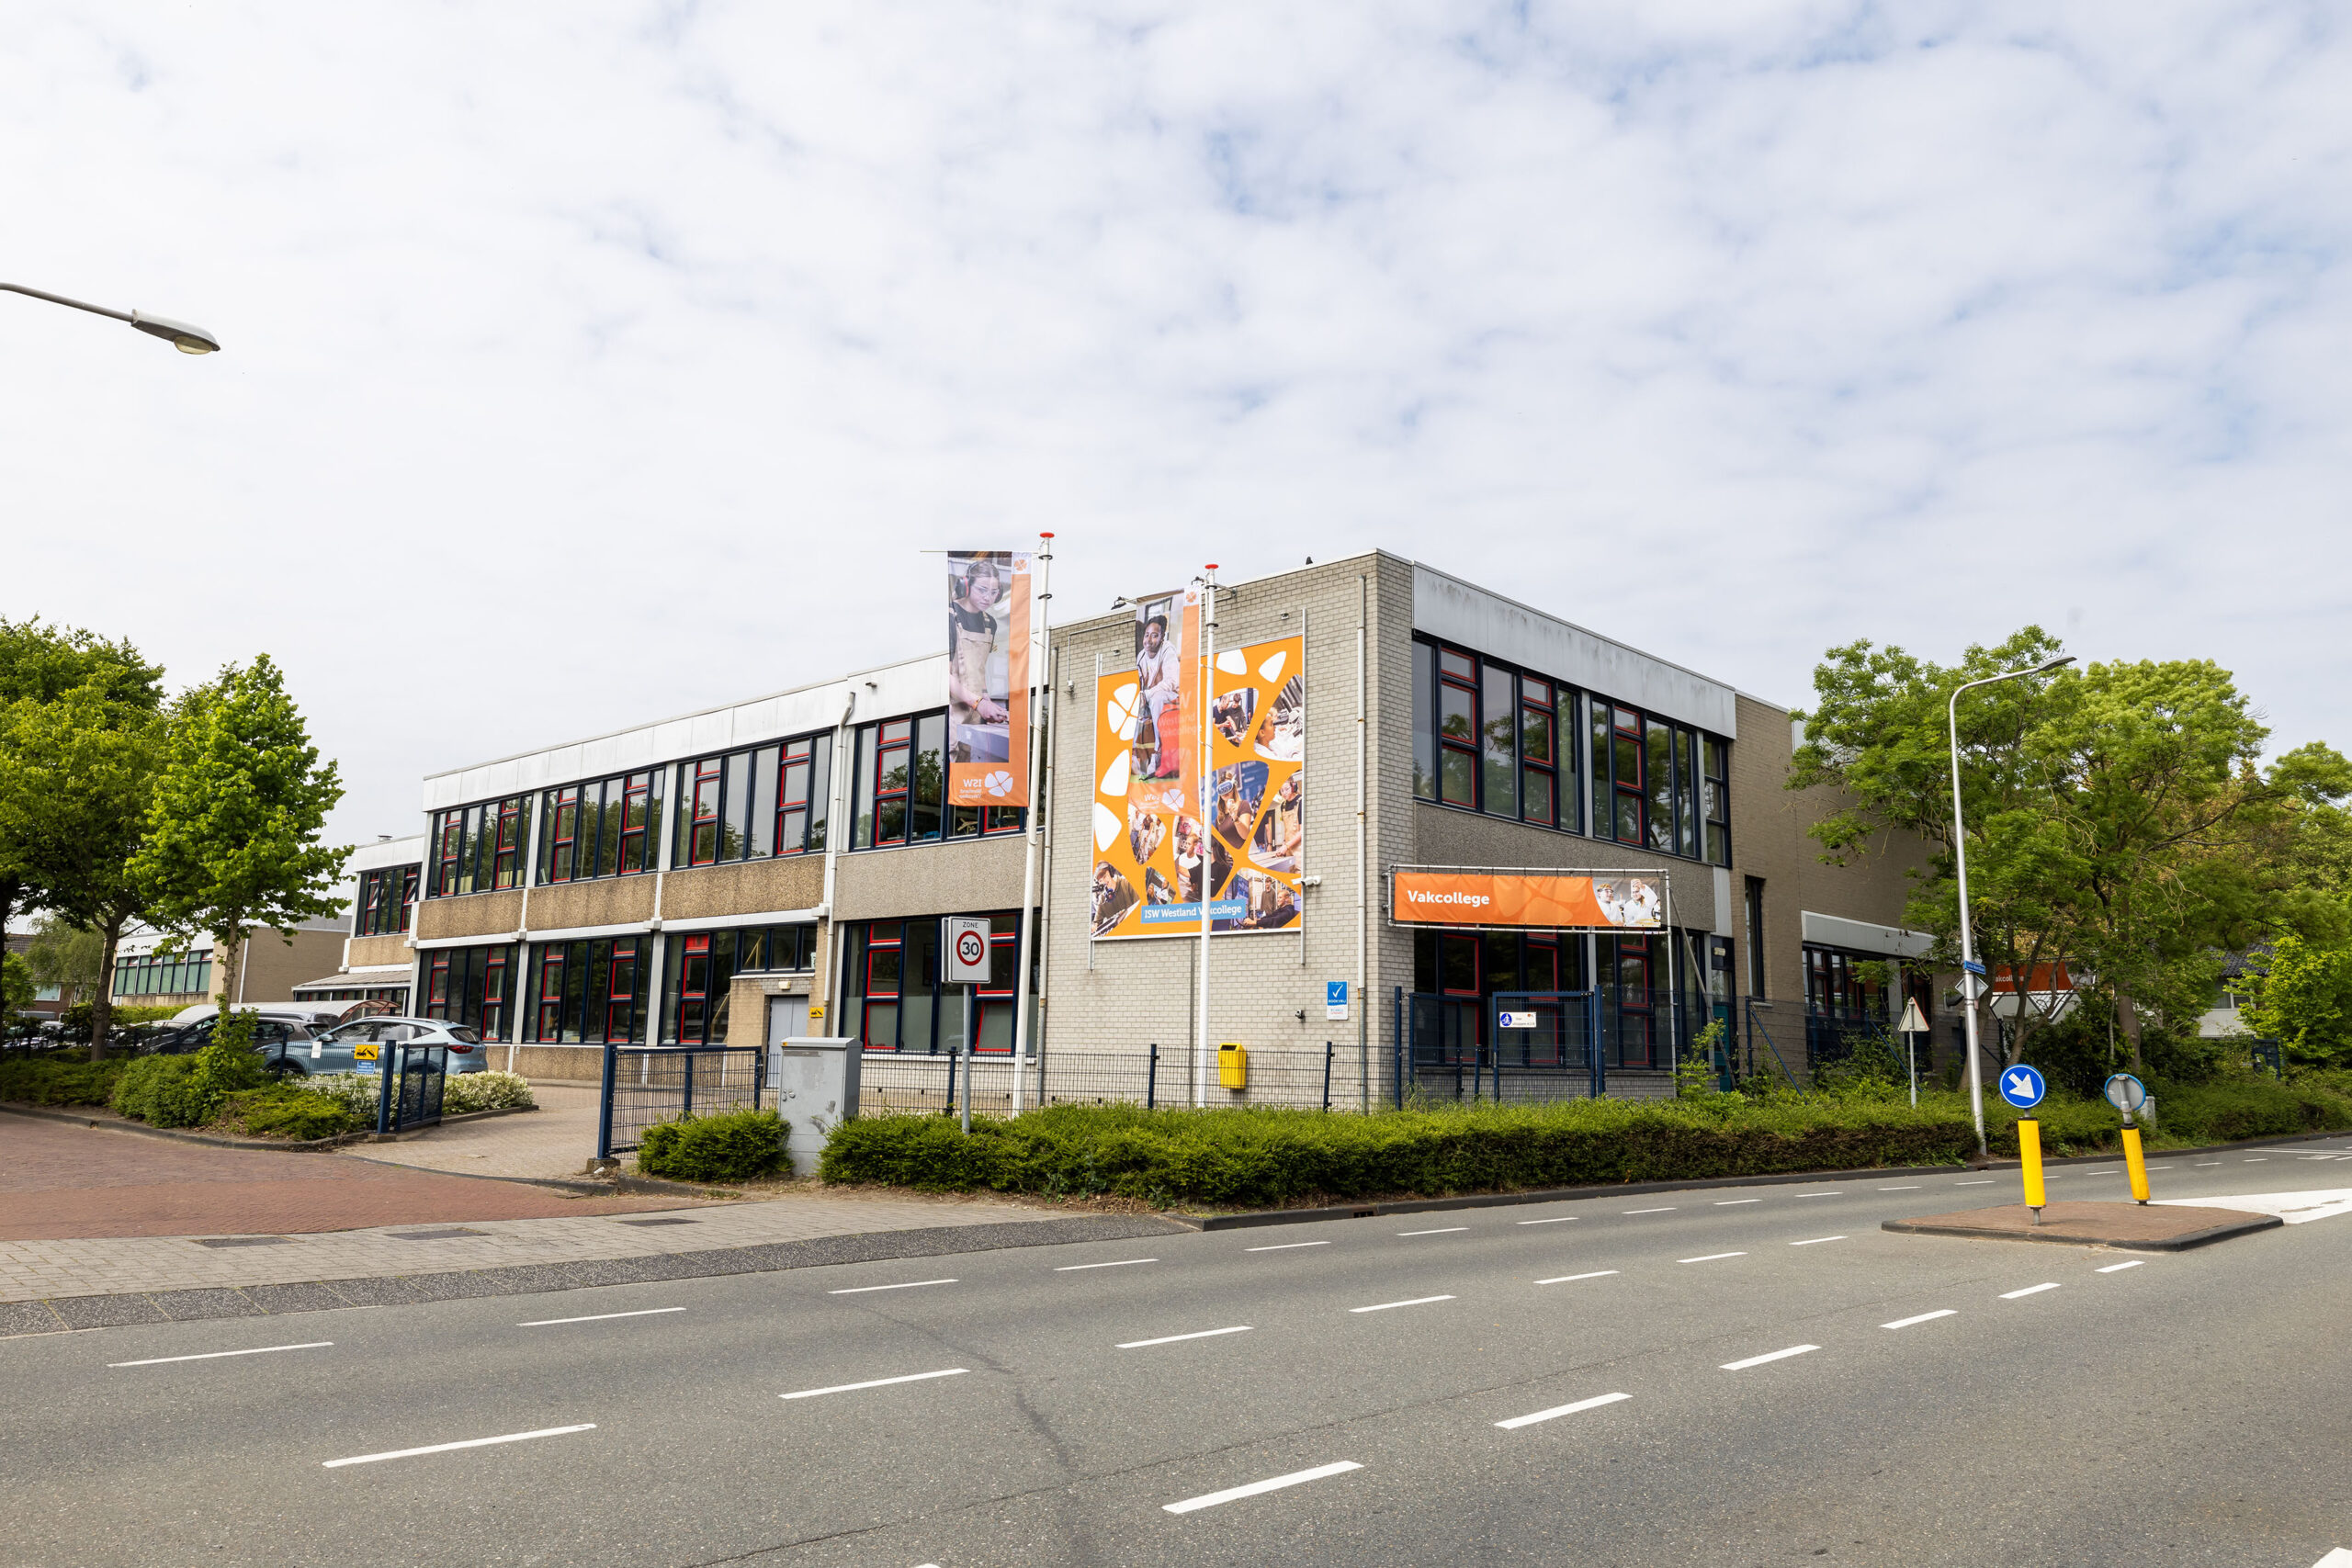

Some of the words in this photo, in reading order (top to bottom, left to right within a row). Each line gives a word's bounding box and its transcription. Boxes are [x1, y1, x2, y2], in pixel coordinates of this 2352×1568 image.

[1407, 889, 1490, 908] Vakcollege
[1144, 909, 1160, 919] ISW
[1160, 907, 1197, 918] Westland
[1198, 904, 1242, 916] Vcollege
[961, 941, 979, 956] 30
